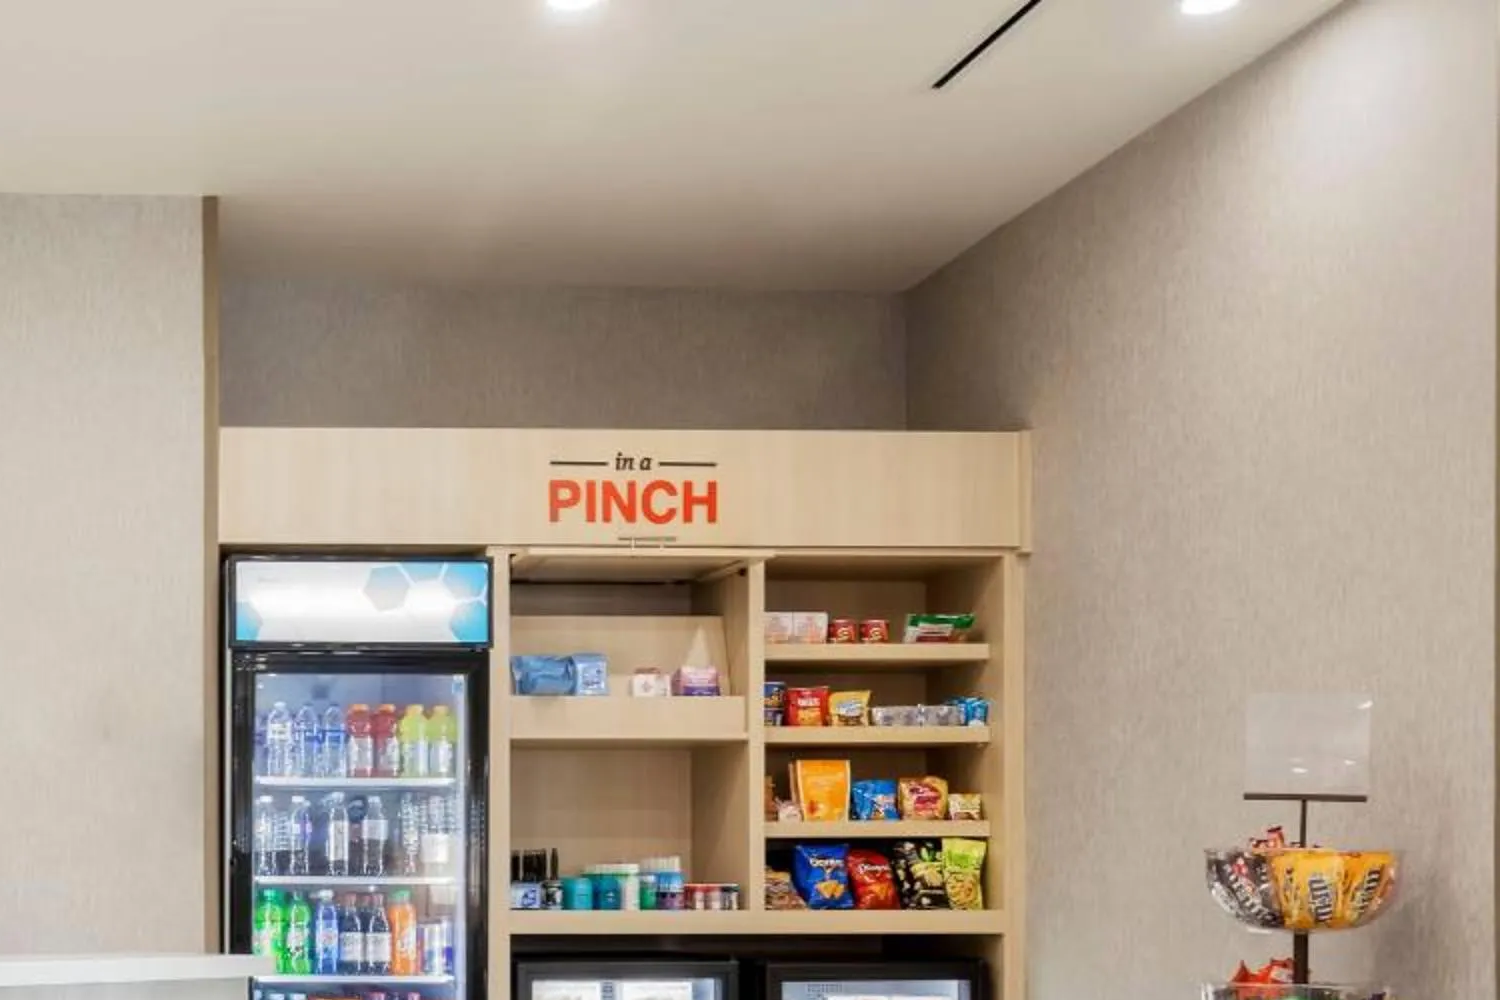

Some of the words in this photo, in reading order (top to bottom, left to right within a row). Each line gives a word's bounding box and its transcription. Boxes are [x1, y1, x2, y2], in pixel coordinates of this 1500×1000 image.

[615, 452, 635, 471] in
[639, 456, 653, 471] a
[548, 479, 719, 525] PINCH
